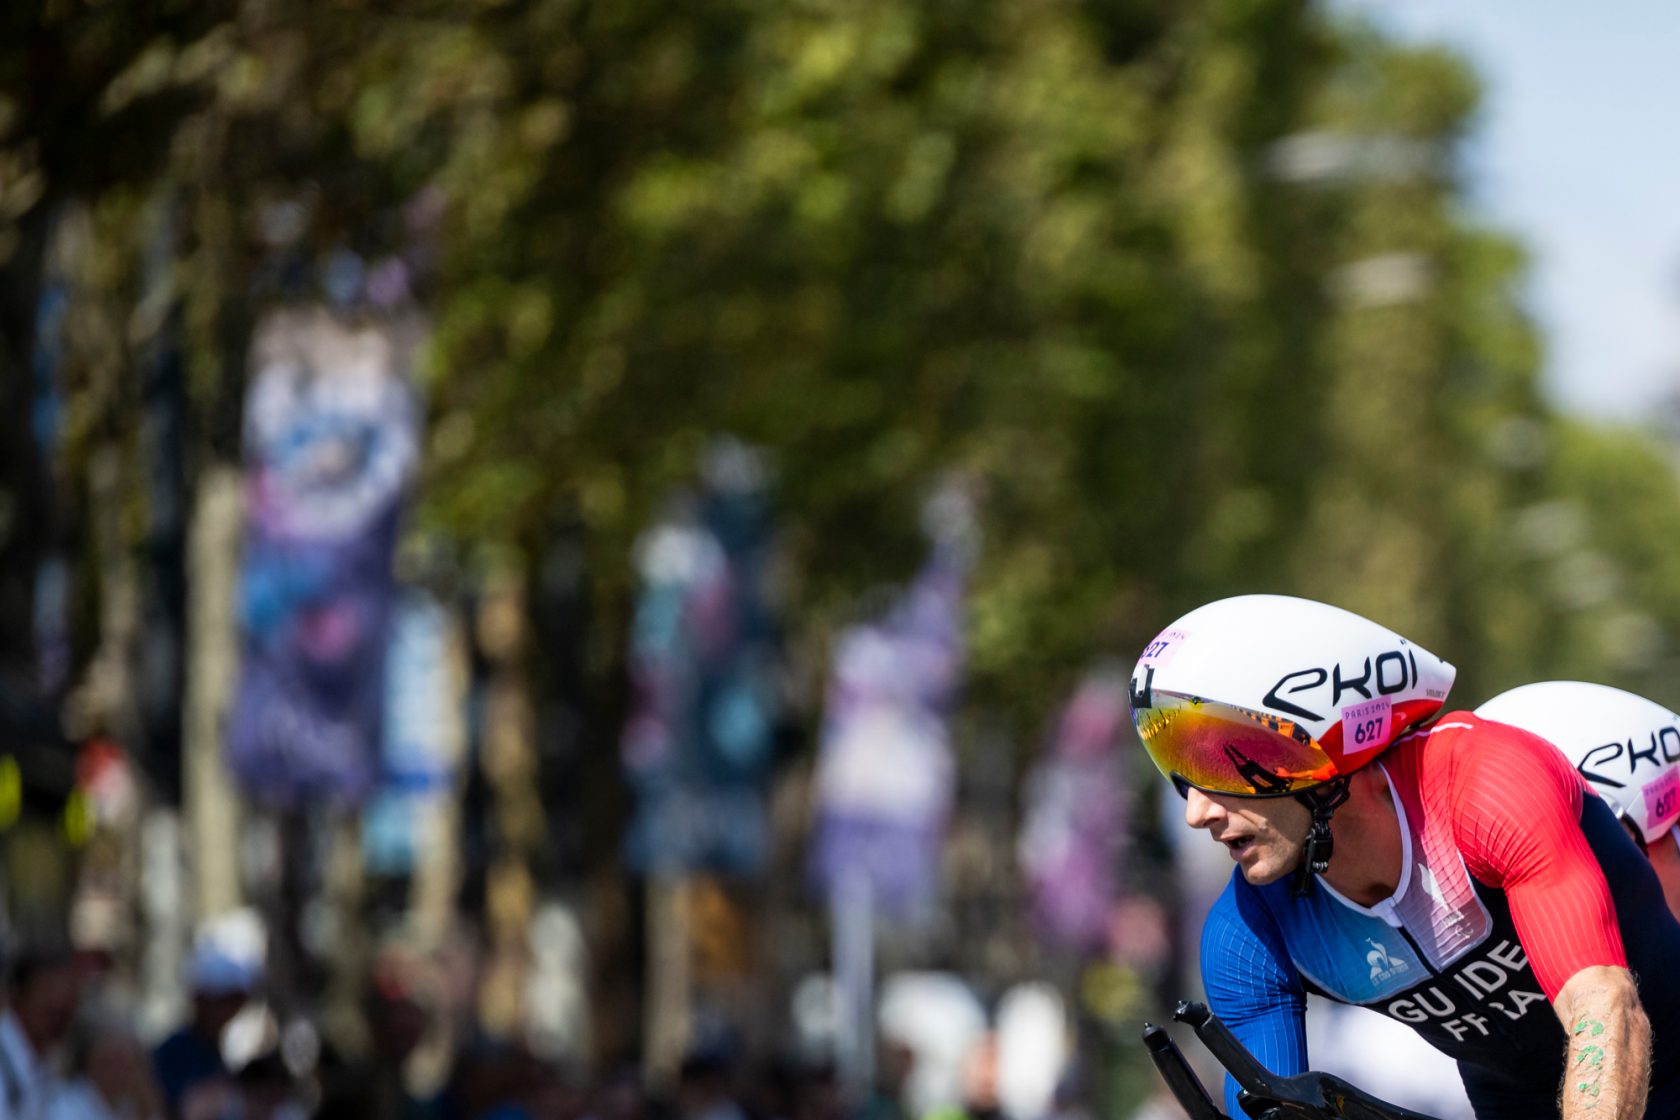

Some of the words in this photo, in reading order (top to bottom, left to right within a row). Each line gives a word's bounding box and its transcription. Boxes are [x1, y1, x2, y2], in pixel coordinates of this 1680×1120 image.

[1345, 707, 1369, 721] PARIS
[1354, 718, 1384, 745] 627
[1655, 788, 1678, 818] 627
